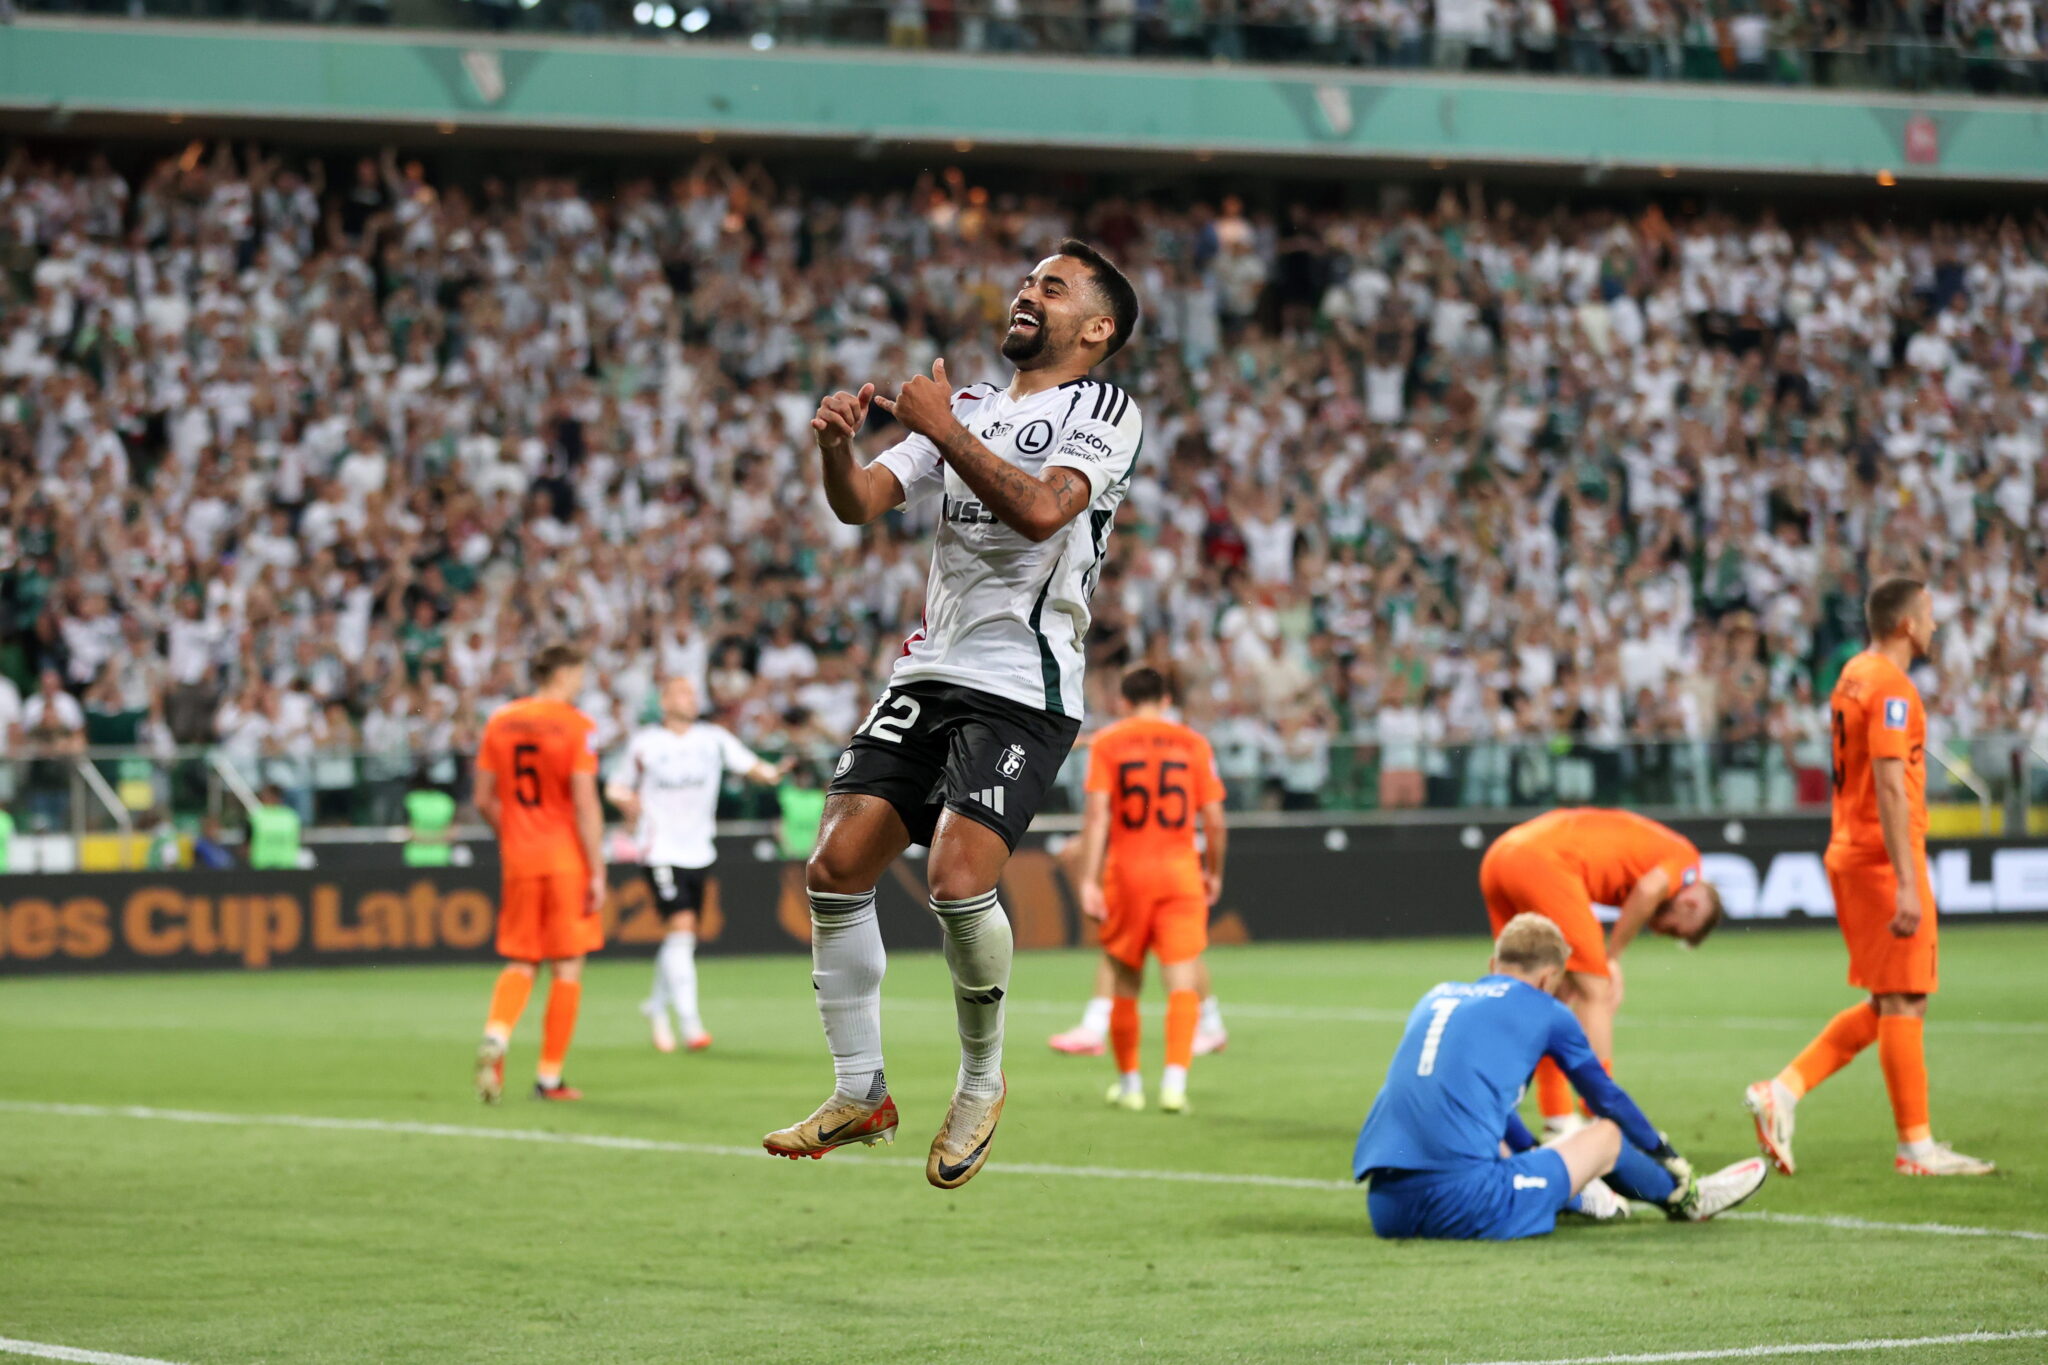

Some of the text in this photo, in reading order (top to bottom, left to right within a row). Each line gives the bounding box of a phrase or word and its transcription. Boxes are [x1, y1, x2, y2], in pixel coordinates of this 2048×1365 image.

[514, 743, 542, 808] 5
[1118, 760, 1188, 829] 55
[0, 880, 495, 969] es Cup Lato
[1417, 998, 1461, 1077] 1
